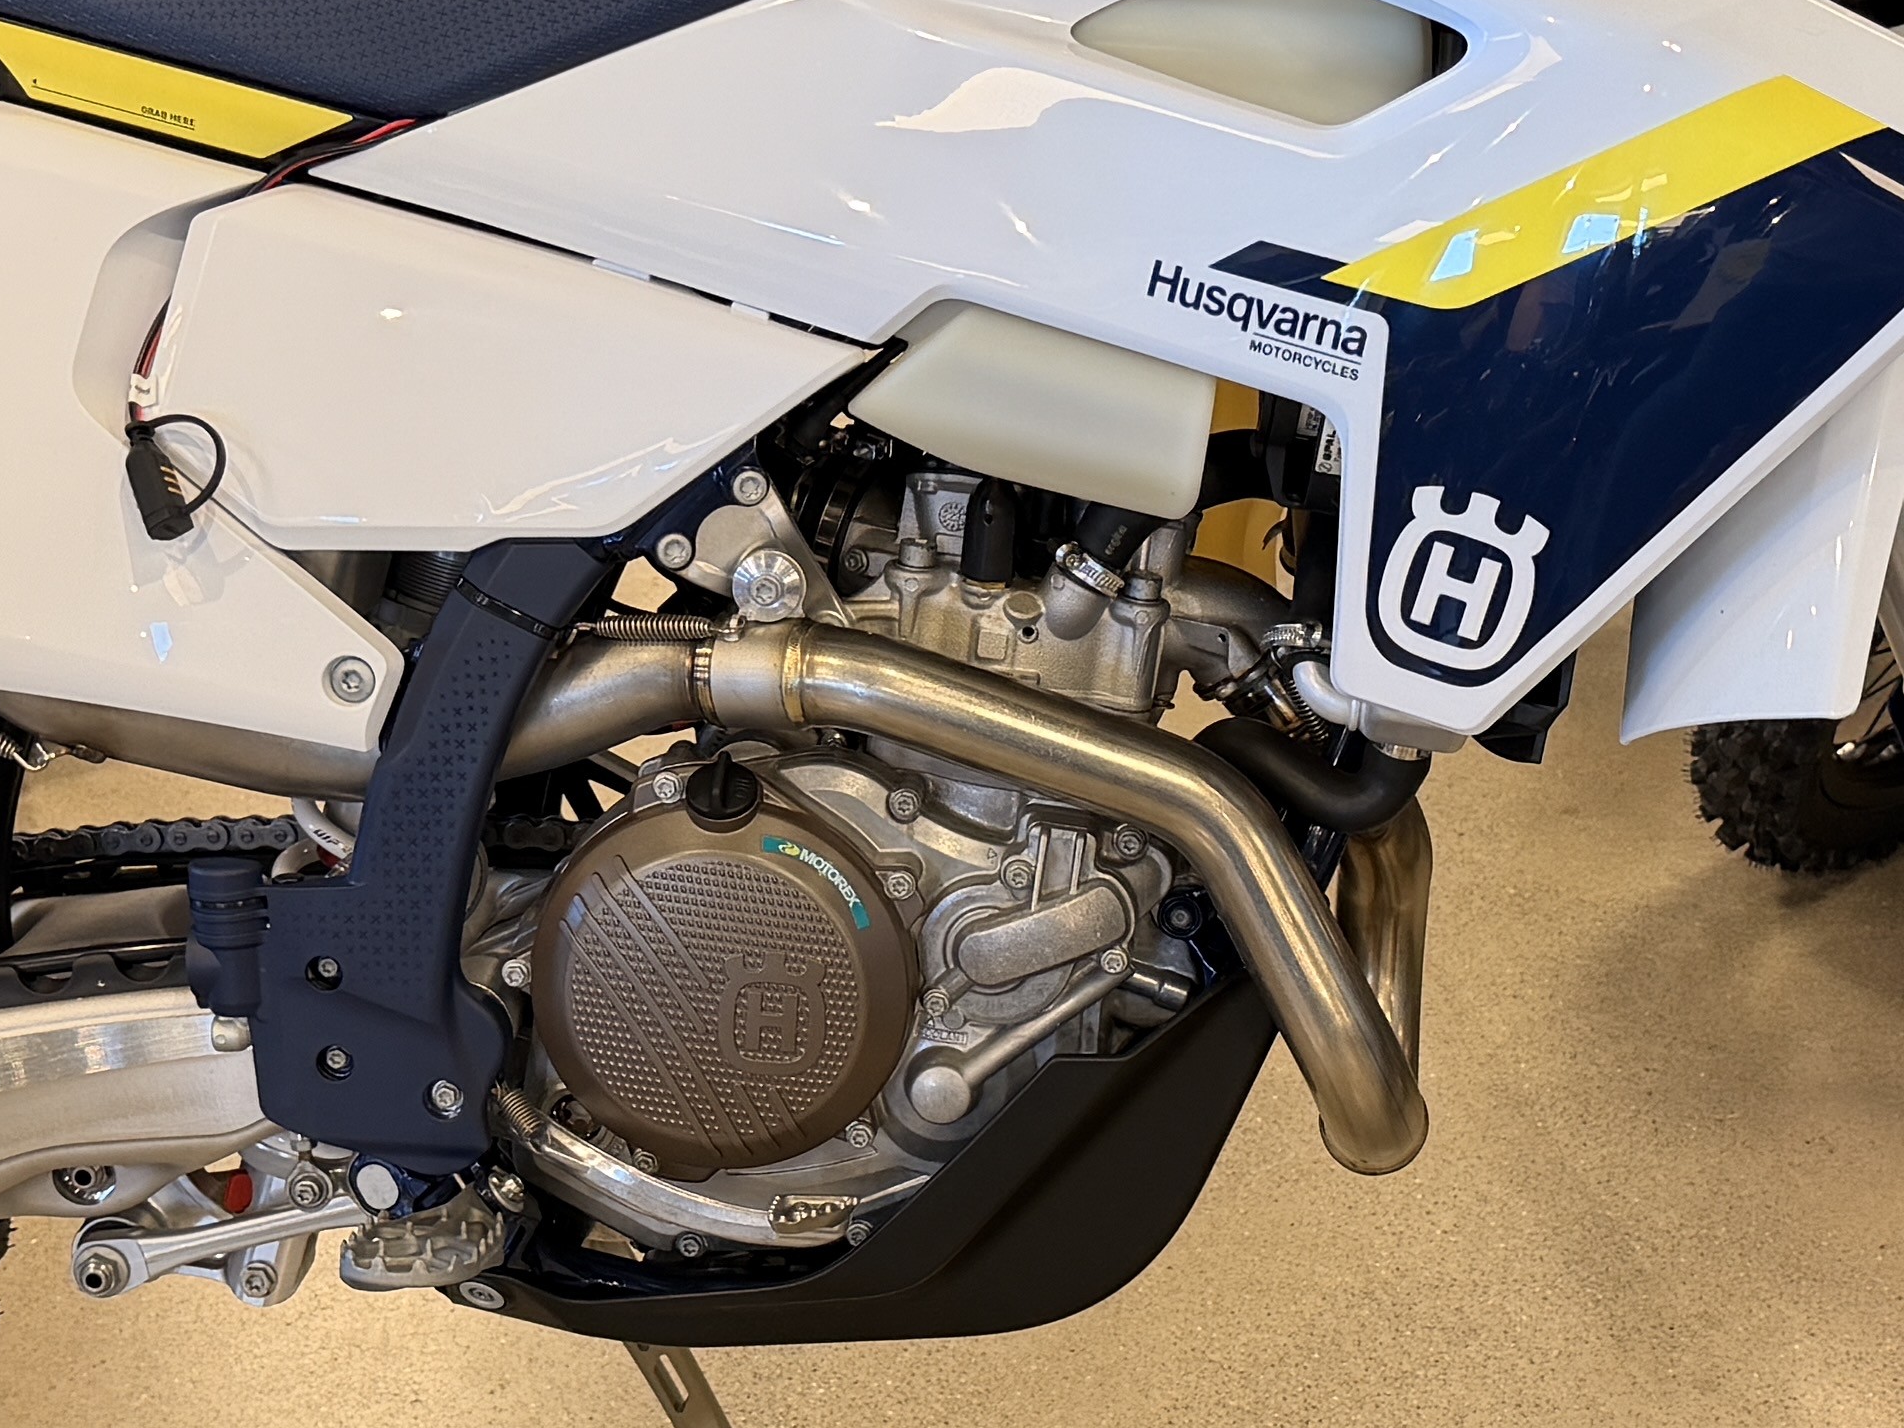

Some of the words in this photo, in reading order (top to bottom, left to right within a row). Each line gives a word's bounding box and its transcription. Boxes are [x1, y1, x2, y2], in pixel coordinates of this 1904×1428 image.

[1147, 259, 1368, 358] Husqvarna
[1249, 338, 1360, 381] MOTORCYCLES
[1410, 541, 1502, 641] H
[799, 848, 863, 908] MOTOREX
